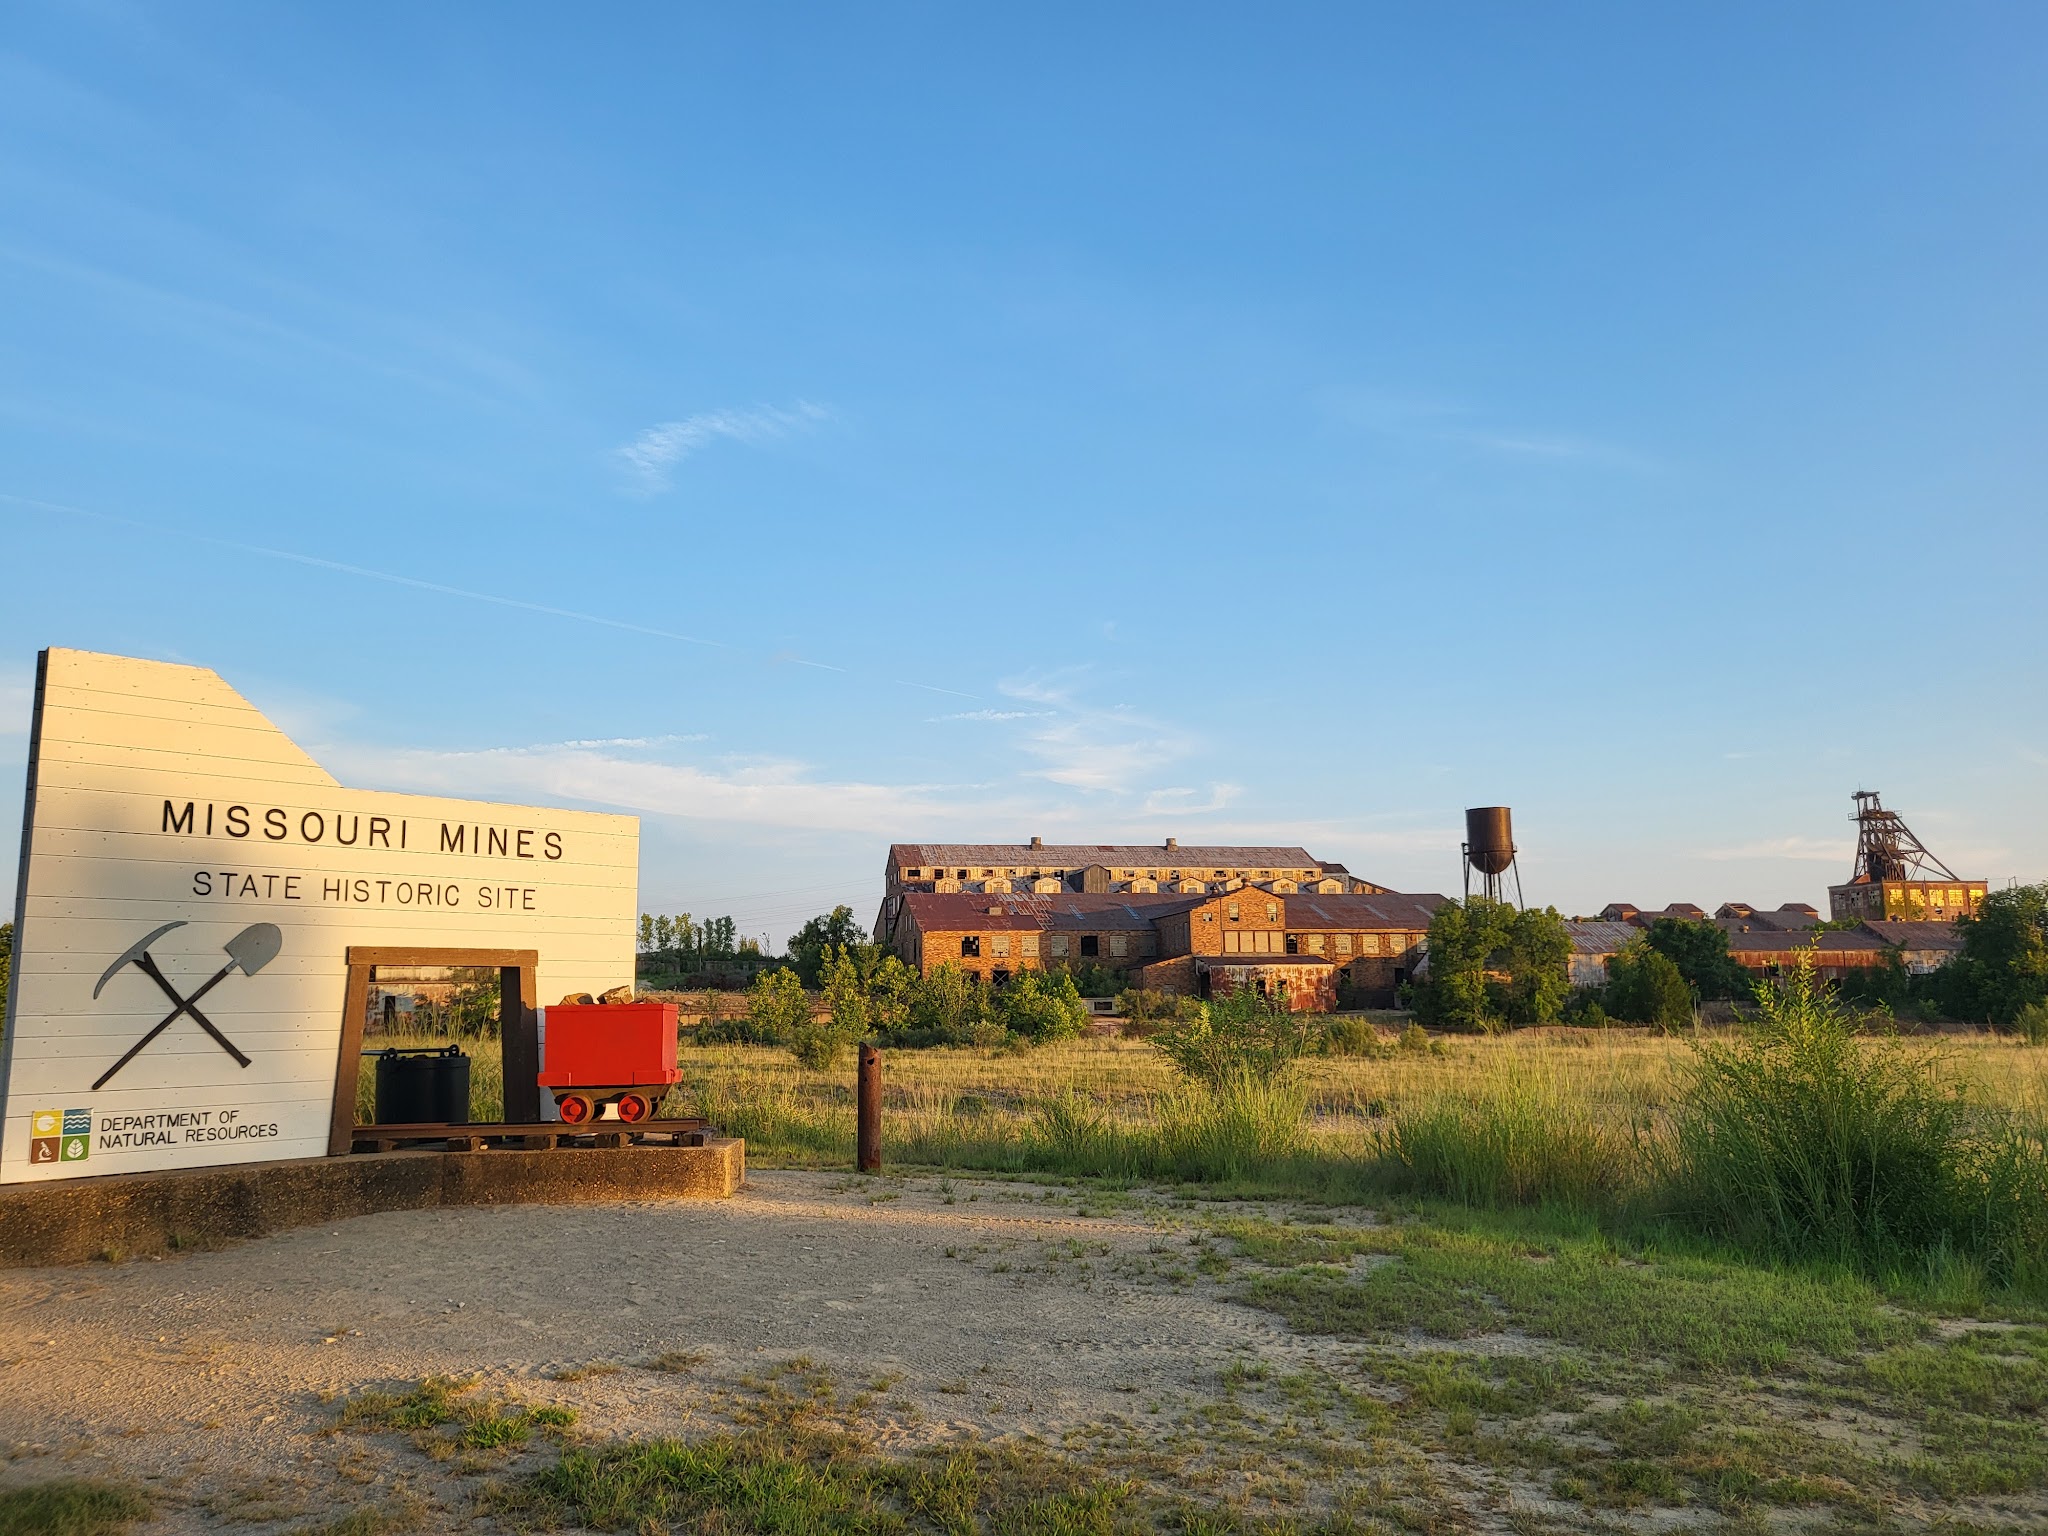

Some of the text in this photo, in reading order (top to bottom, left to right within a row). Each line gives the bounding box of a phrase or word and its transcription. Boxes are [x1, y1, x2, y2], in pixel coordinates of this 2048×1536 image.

[162, 800, 563, 860] MISSOURI MINES
[193, 872, 536, 910] STATE HISTORIC SITE
[99, 1123, 278, 1149] NATURAL RESOURCES
[101, 1110, 240, 1132] DEPARTMENT OF
